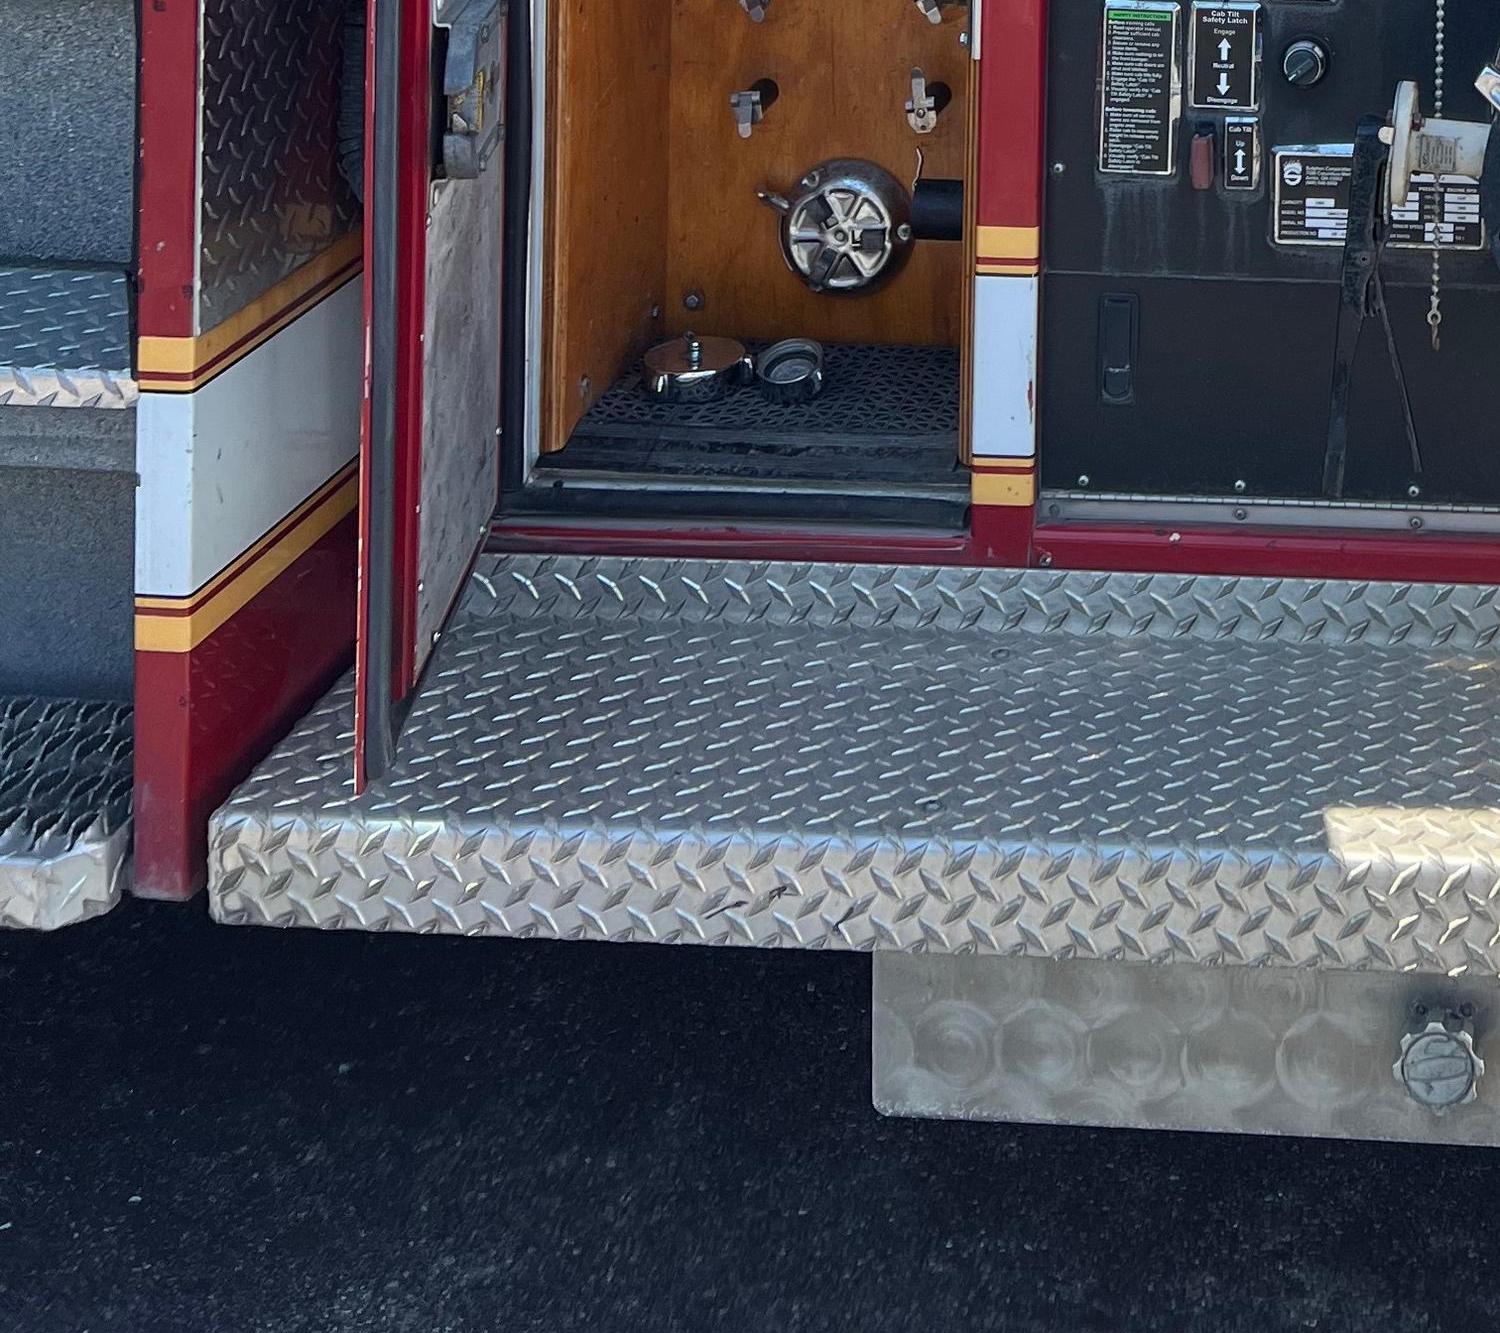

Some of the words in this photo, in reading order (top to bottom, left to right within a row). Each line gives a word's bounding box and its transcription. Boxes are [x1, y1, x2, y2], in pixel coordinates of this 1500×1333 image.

[1227, 10, 1240, 18] Tilt
[1202, 16, 1226, 24] Safety
[1213, 28, 1236, 36] Engage
[1235, 140, 1245, 148] Up
